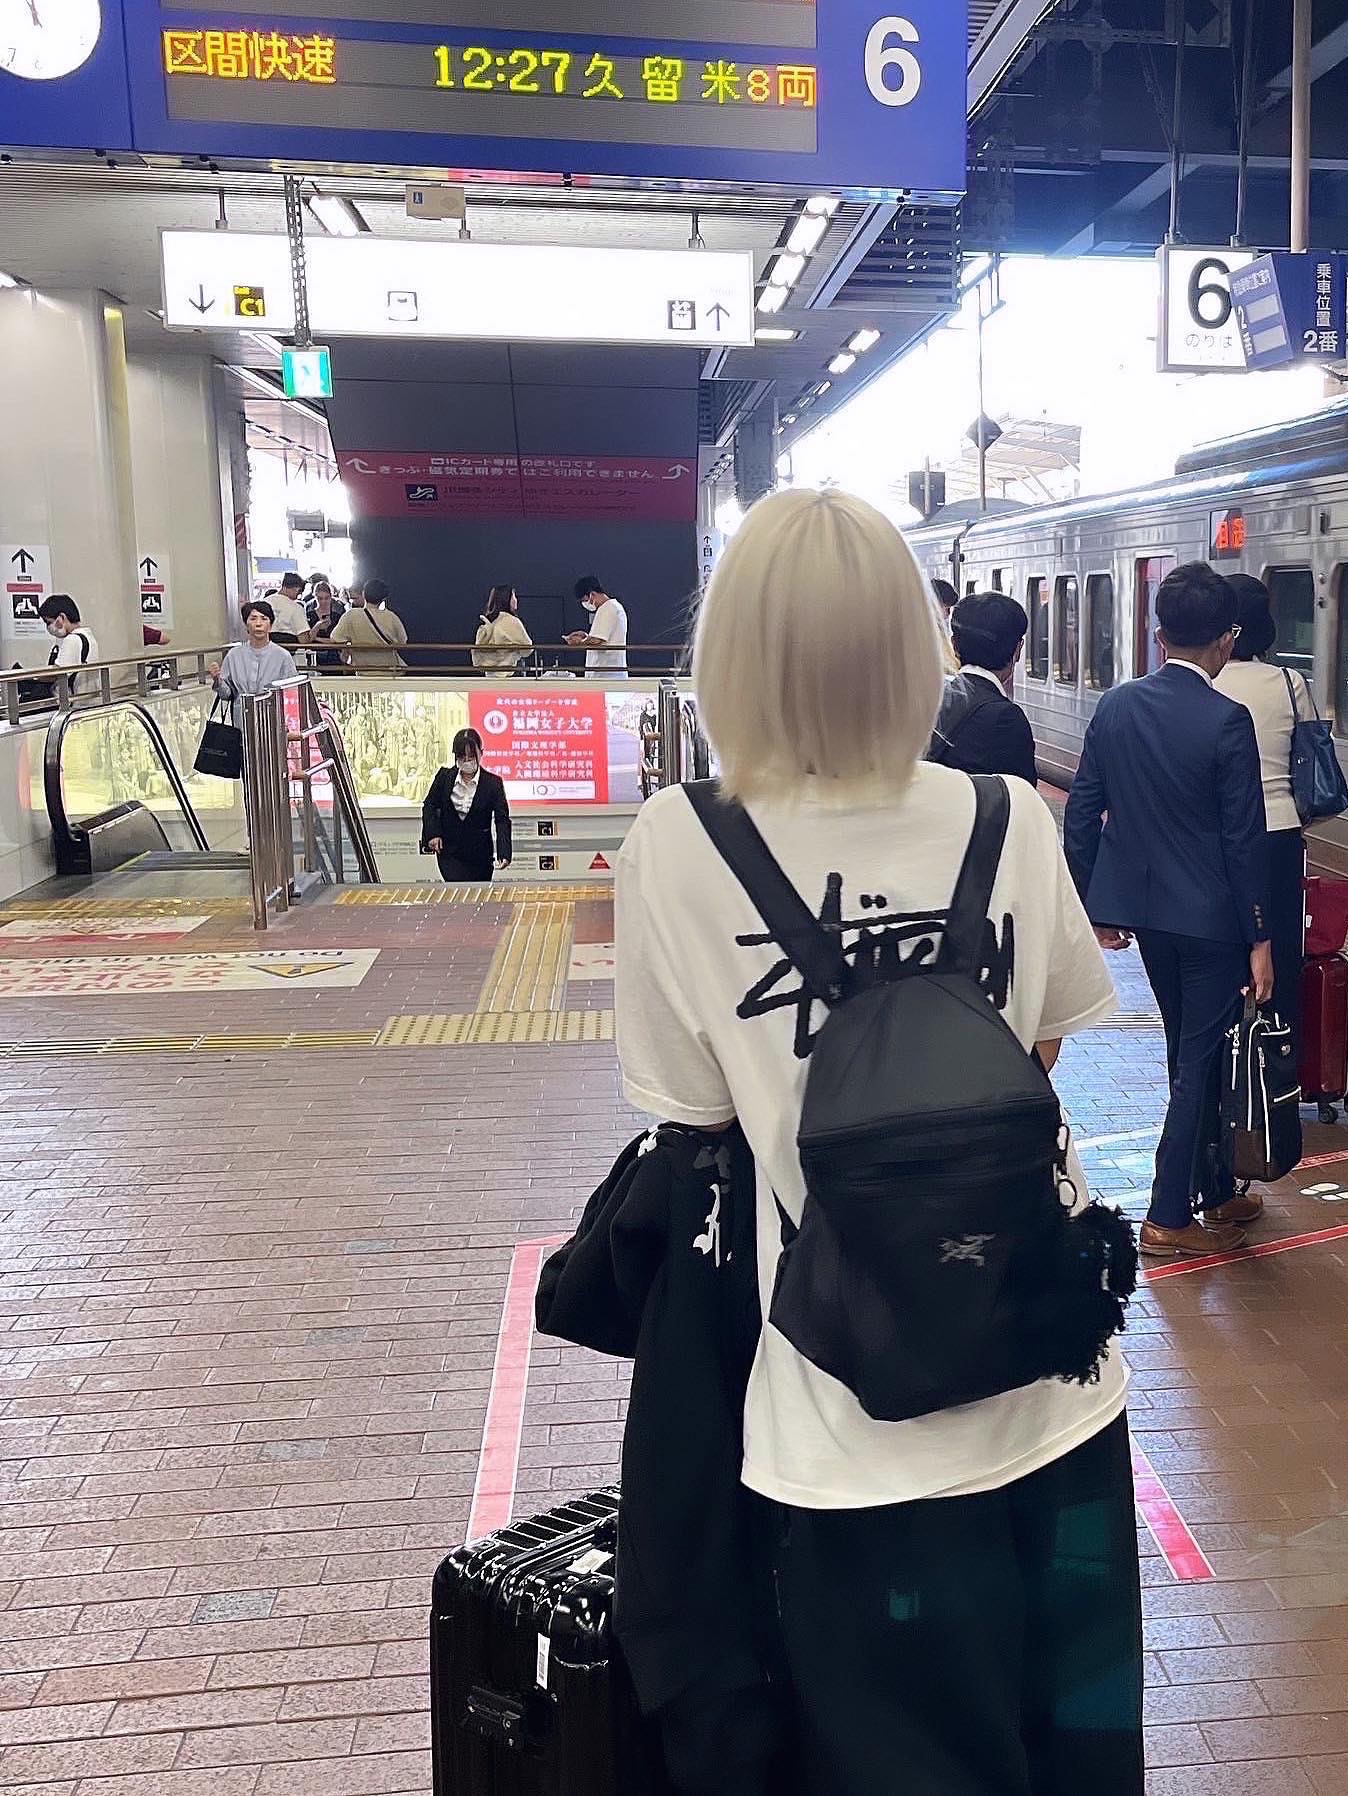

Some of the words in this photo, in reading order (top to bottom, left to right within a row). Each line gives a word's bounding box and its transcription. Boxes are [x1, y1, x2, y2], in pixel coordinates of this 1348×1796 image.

[163, 30, 337, 84] 区間快速
[433, 45, 570, 93] 12:27
[746, 64, 817, 107] 8両
[864, 16, 921, 107] 6
[240, 298, 264, 316] C1
[1188, 257, 1233, 330] 6
[1316, 263, 1331, 327] 乗車位置
[1303, 330, 1338, 352] 2番
[512, 717, 592, 730] 福岡女子大学
